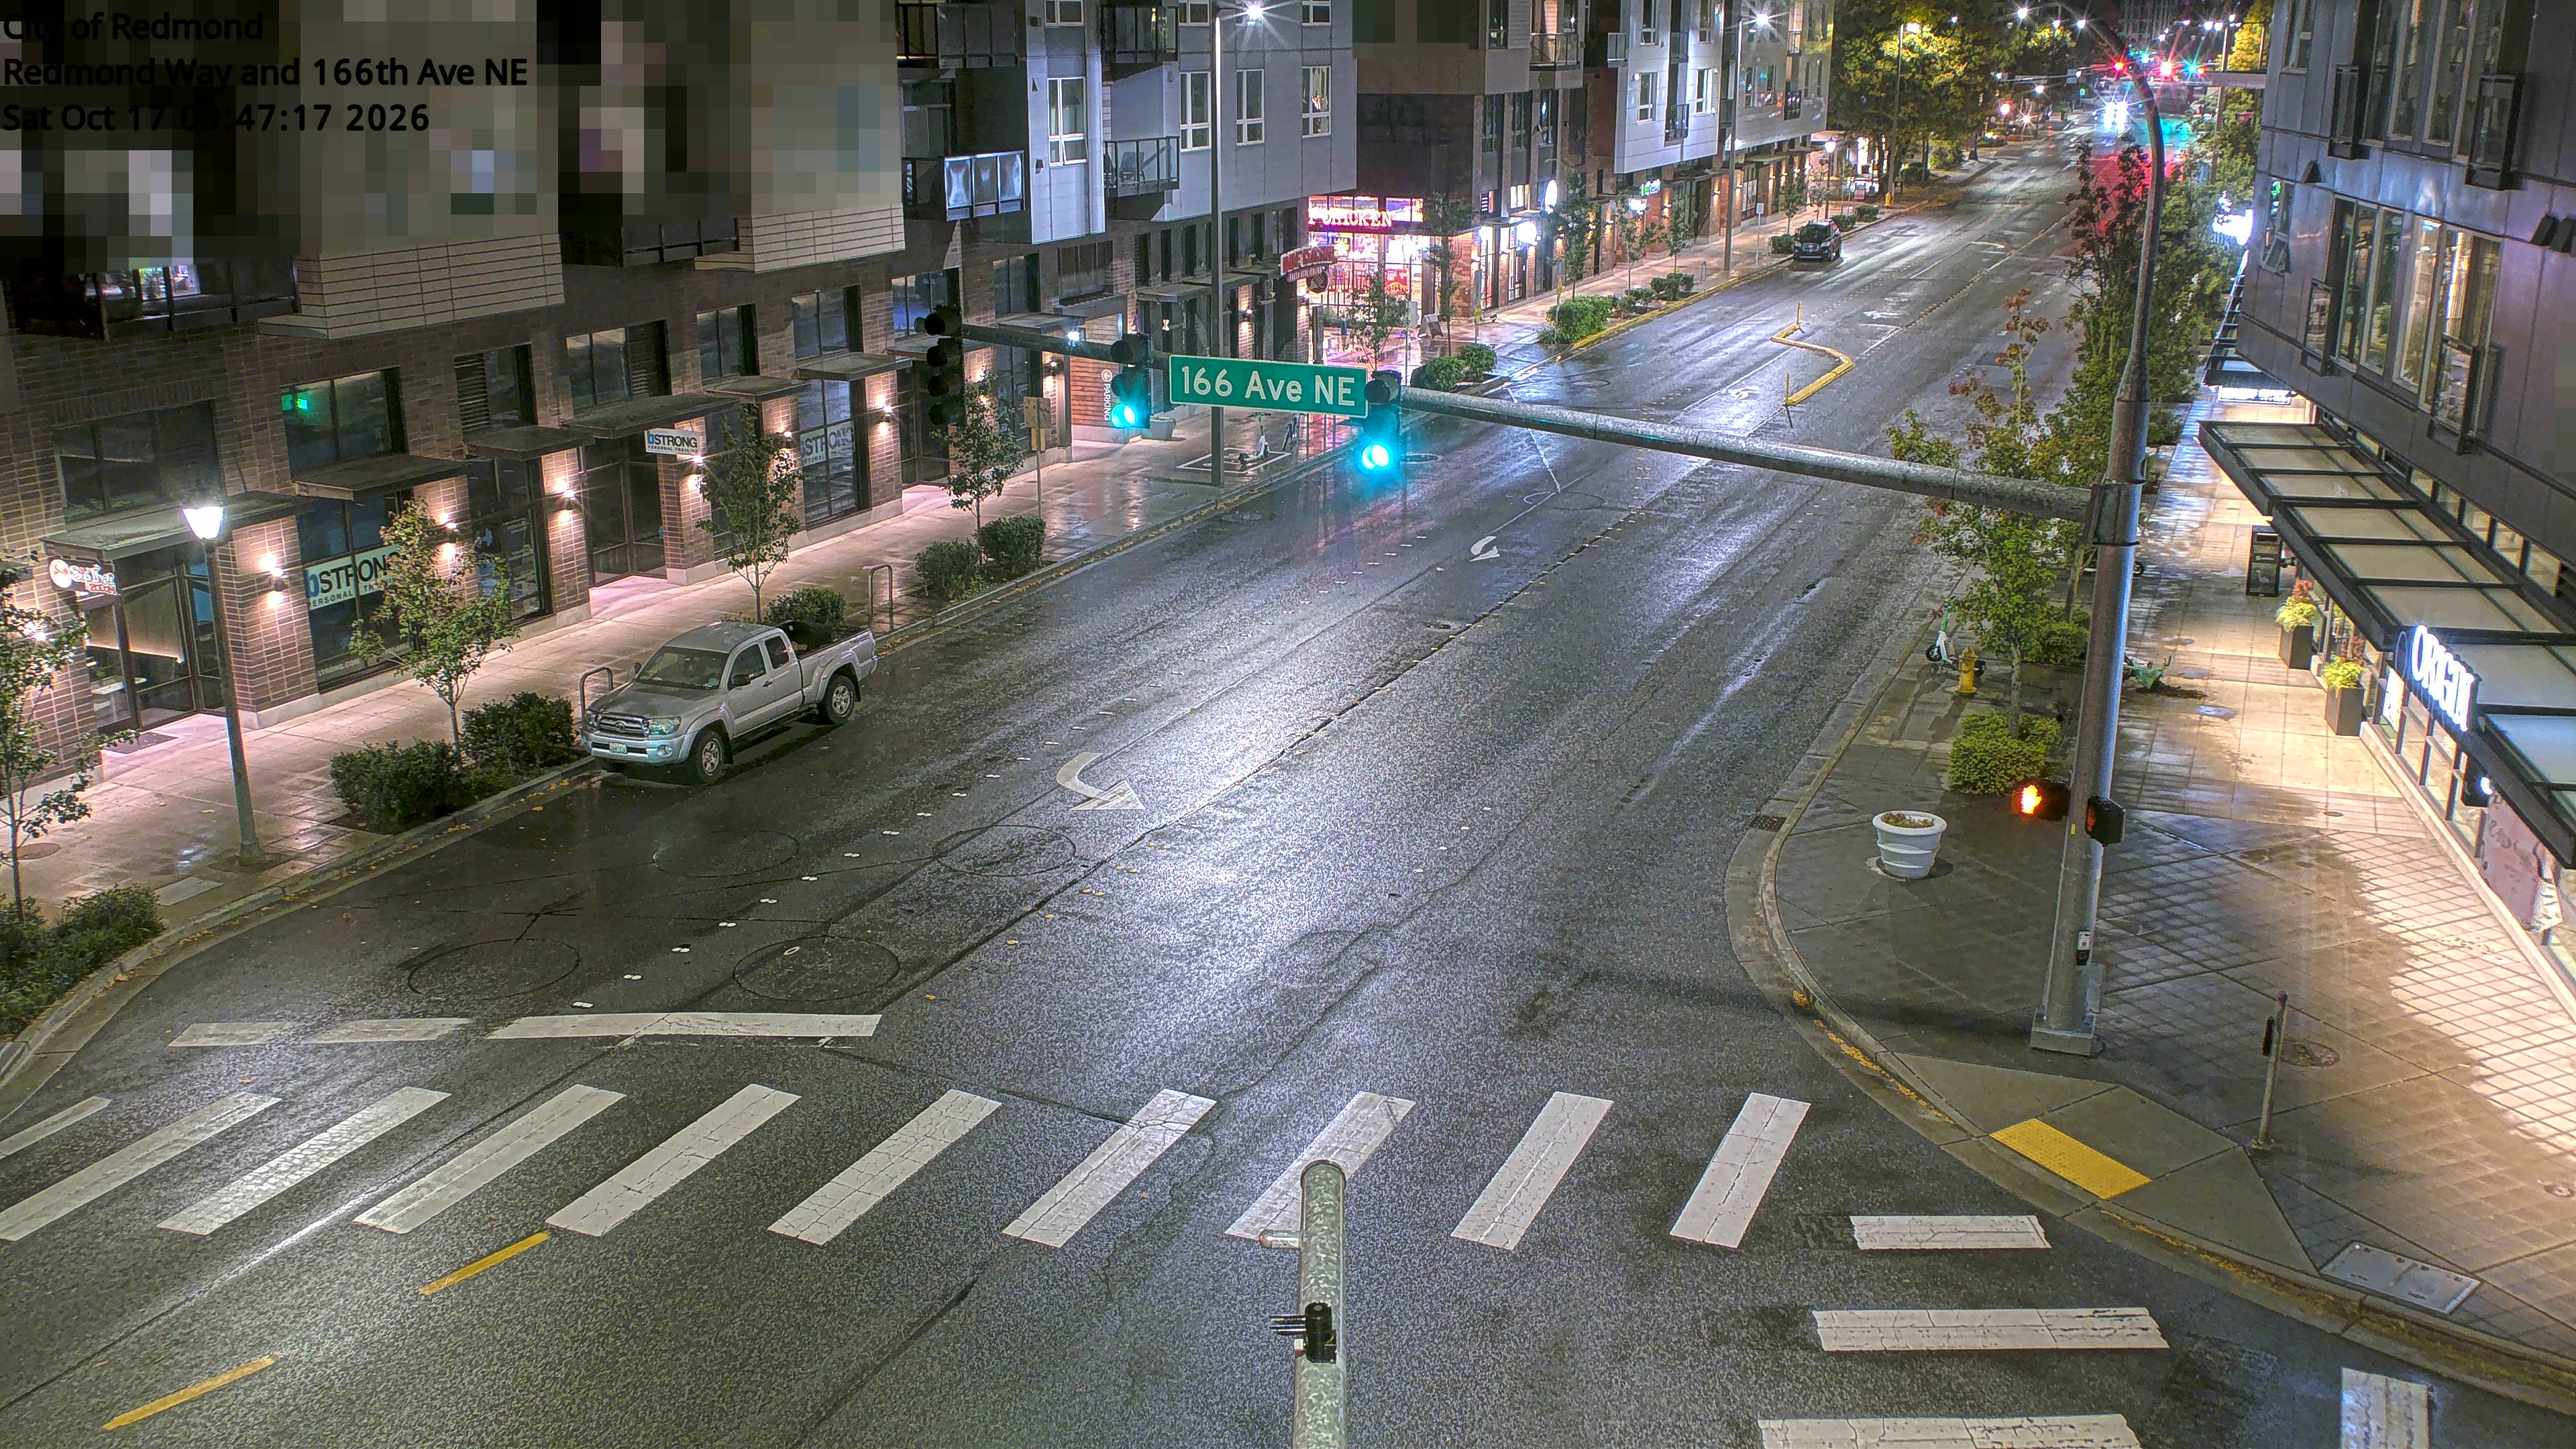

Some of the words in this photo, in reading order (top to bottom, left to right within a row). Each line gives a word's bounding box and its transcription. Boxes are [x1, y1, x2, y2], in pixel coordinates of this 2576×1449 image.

[1181, 366, 1233, 396] 166
[1244, 371, 1302, 402] Ave
[1315, 374, 1355, 406] NE
[647, 430, 698, 448] bSTRONG
[309, 590, 354, 607] ERSONAL
